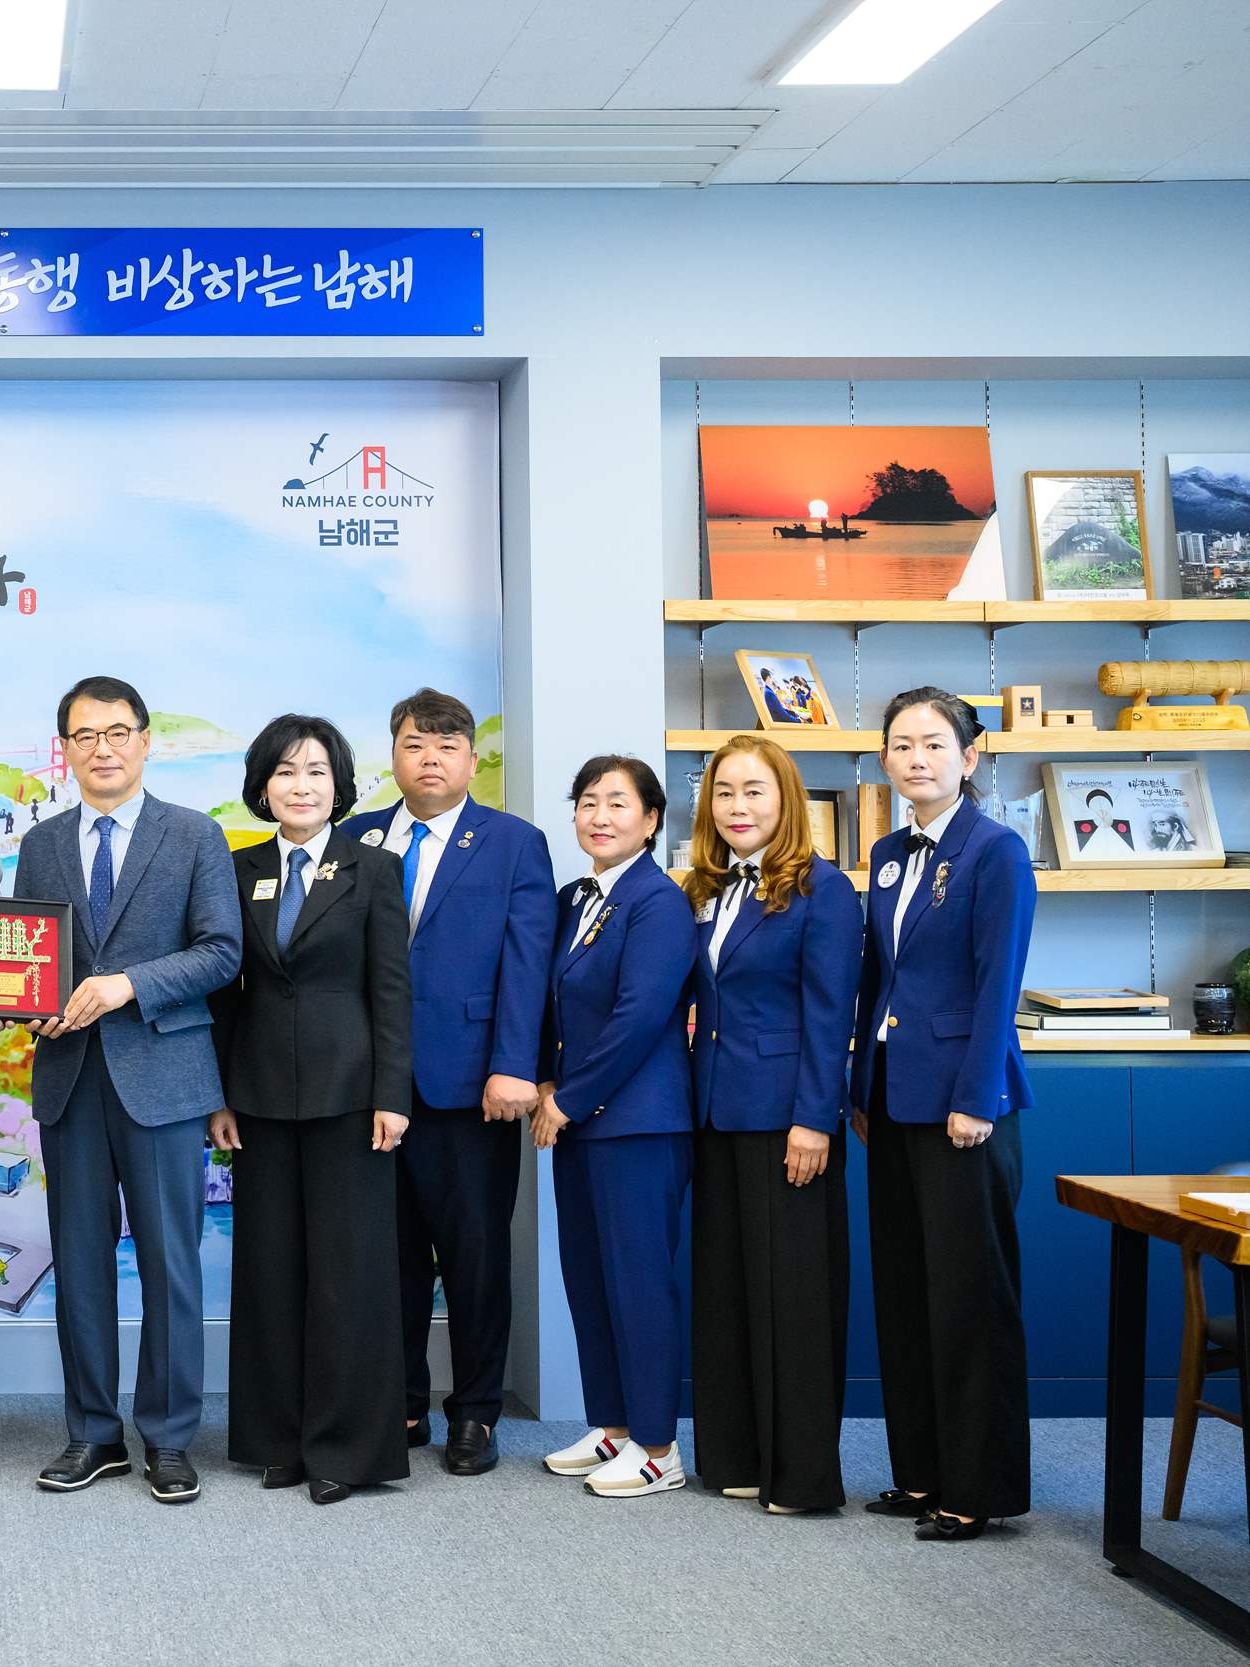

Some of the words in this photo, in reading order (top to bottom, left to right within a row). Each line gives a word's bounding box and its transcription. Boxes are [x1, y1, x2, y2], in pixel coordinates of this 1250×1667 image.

[106, 248, 303, 311] 비상하는
[313, 249, 414, 310] 남해
[282, 495, 357, 508] NAMHAE
[362, 495, 435, 508] COUNTY
[318, 518, 400, 547] 남해군
